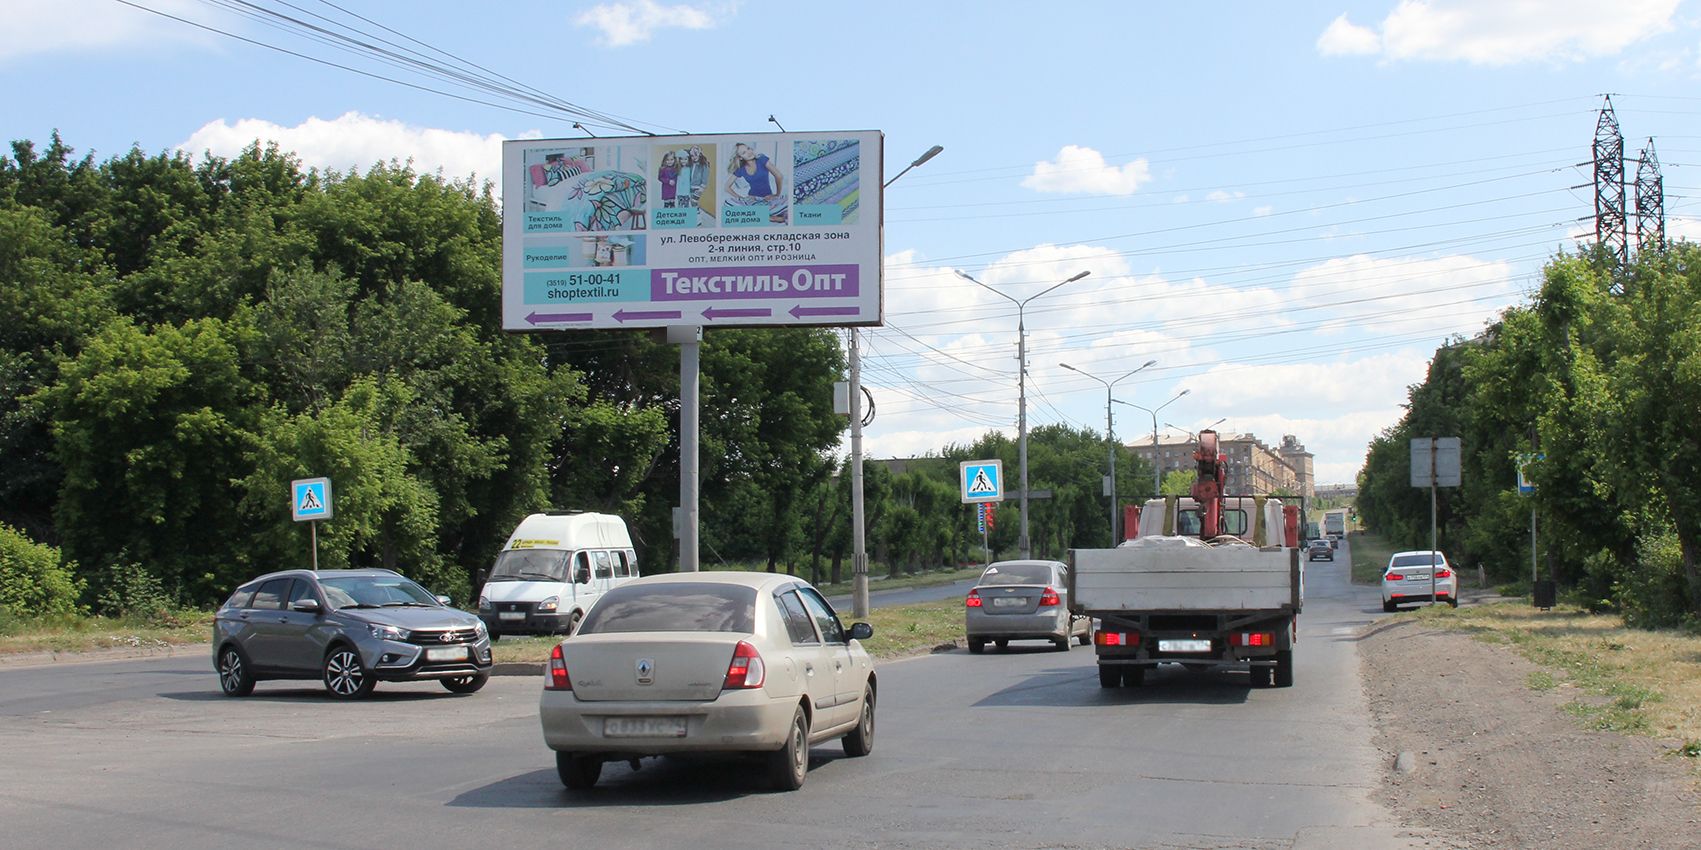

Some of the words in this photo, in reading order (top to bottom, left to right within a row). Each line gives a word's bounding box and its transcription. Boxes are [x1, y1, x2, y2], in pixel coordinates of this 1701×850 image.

[724, 216, 739, 224] для
[799, 211, 822, 219] Ткани
[656, 218, 685, 226] одежда
[660, 235, 676, 245] ул.
[679, 234, 760, 245] Левобережная
[763, 232, 821, 243] складская
[824, 231, 850, 241] зона
[708, 244, 725, 253] 2-я
[767, 242, 801, 253] стр.10
[526, 254, 567, 262] Рукоделие
[710, 254, 746, 262] МЕЛКИЙ
[748, 253, 765, 261] ОПТ
[775, 253, 816, 262] РОЗНИЦА
[546, 279, 567, 287] (3519)
[569, 274, 620, 286] 51-00-41
[661, 272, 789, 294] Текстиль
[792, 268, 846, 291] Опт
[547, 286, 619, 301] shoptextil.ru
[511, 539, 521, 549] 22
